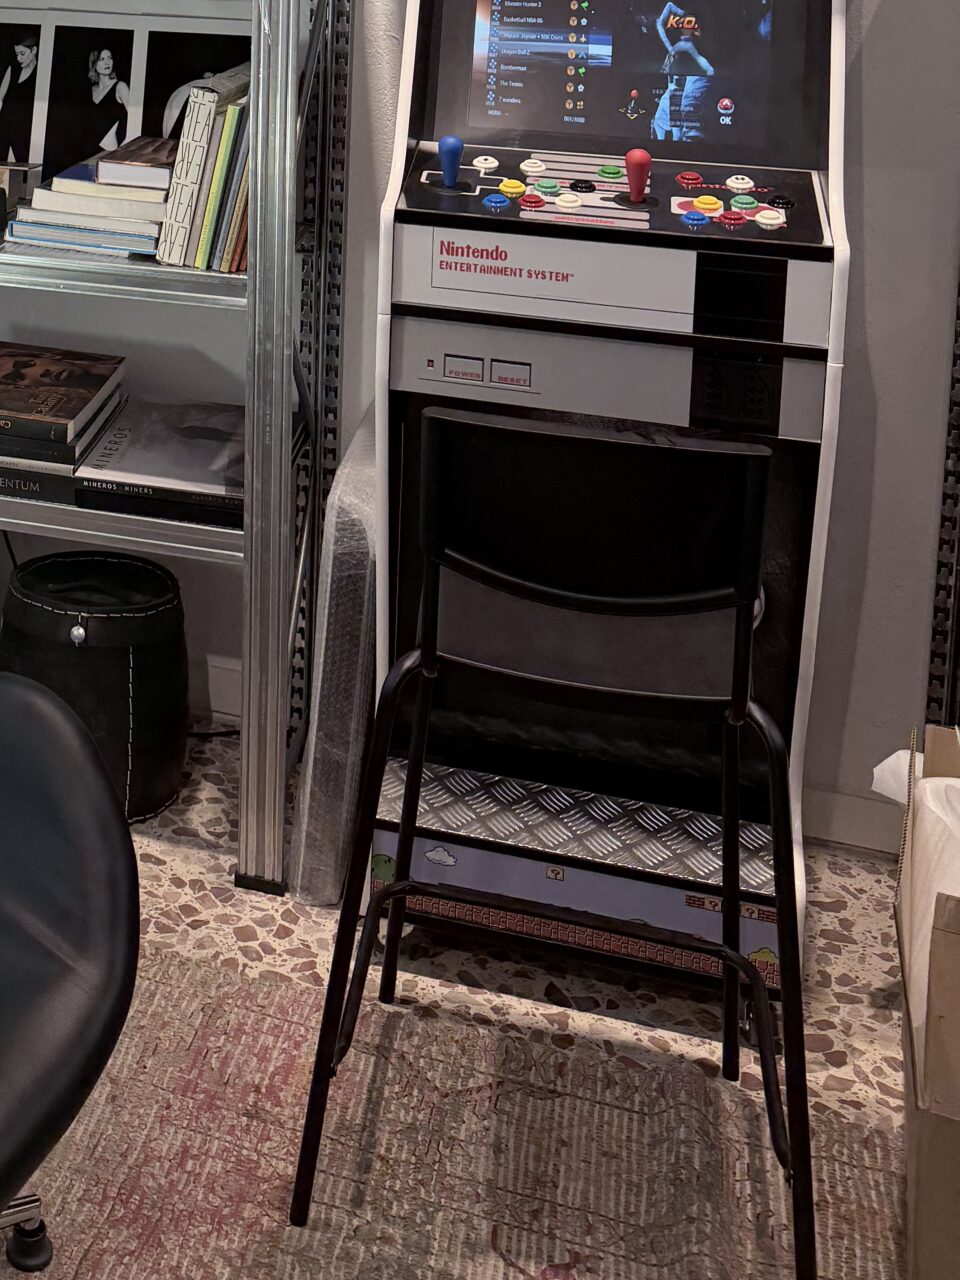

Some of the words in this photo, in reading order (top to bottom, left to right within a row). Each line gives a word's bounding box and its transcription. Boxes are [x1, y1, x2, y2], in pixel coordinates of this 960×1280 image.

[719, 116, 732, 125] OK
[440, 240, 508, 261] Nintendo
[439, 260, 524, 278] ENTERTAINMENT
[449, 369, 481, 379] POWER
[498, 375, 528, 385] RESET
[93, 427, 133, 471] MINEROS
[83, 480, 117, 490] MINEROS
[124, 485, 153, 495] MINERS
